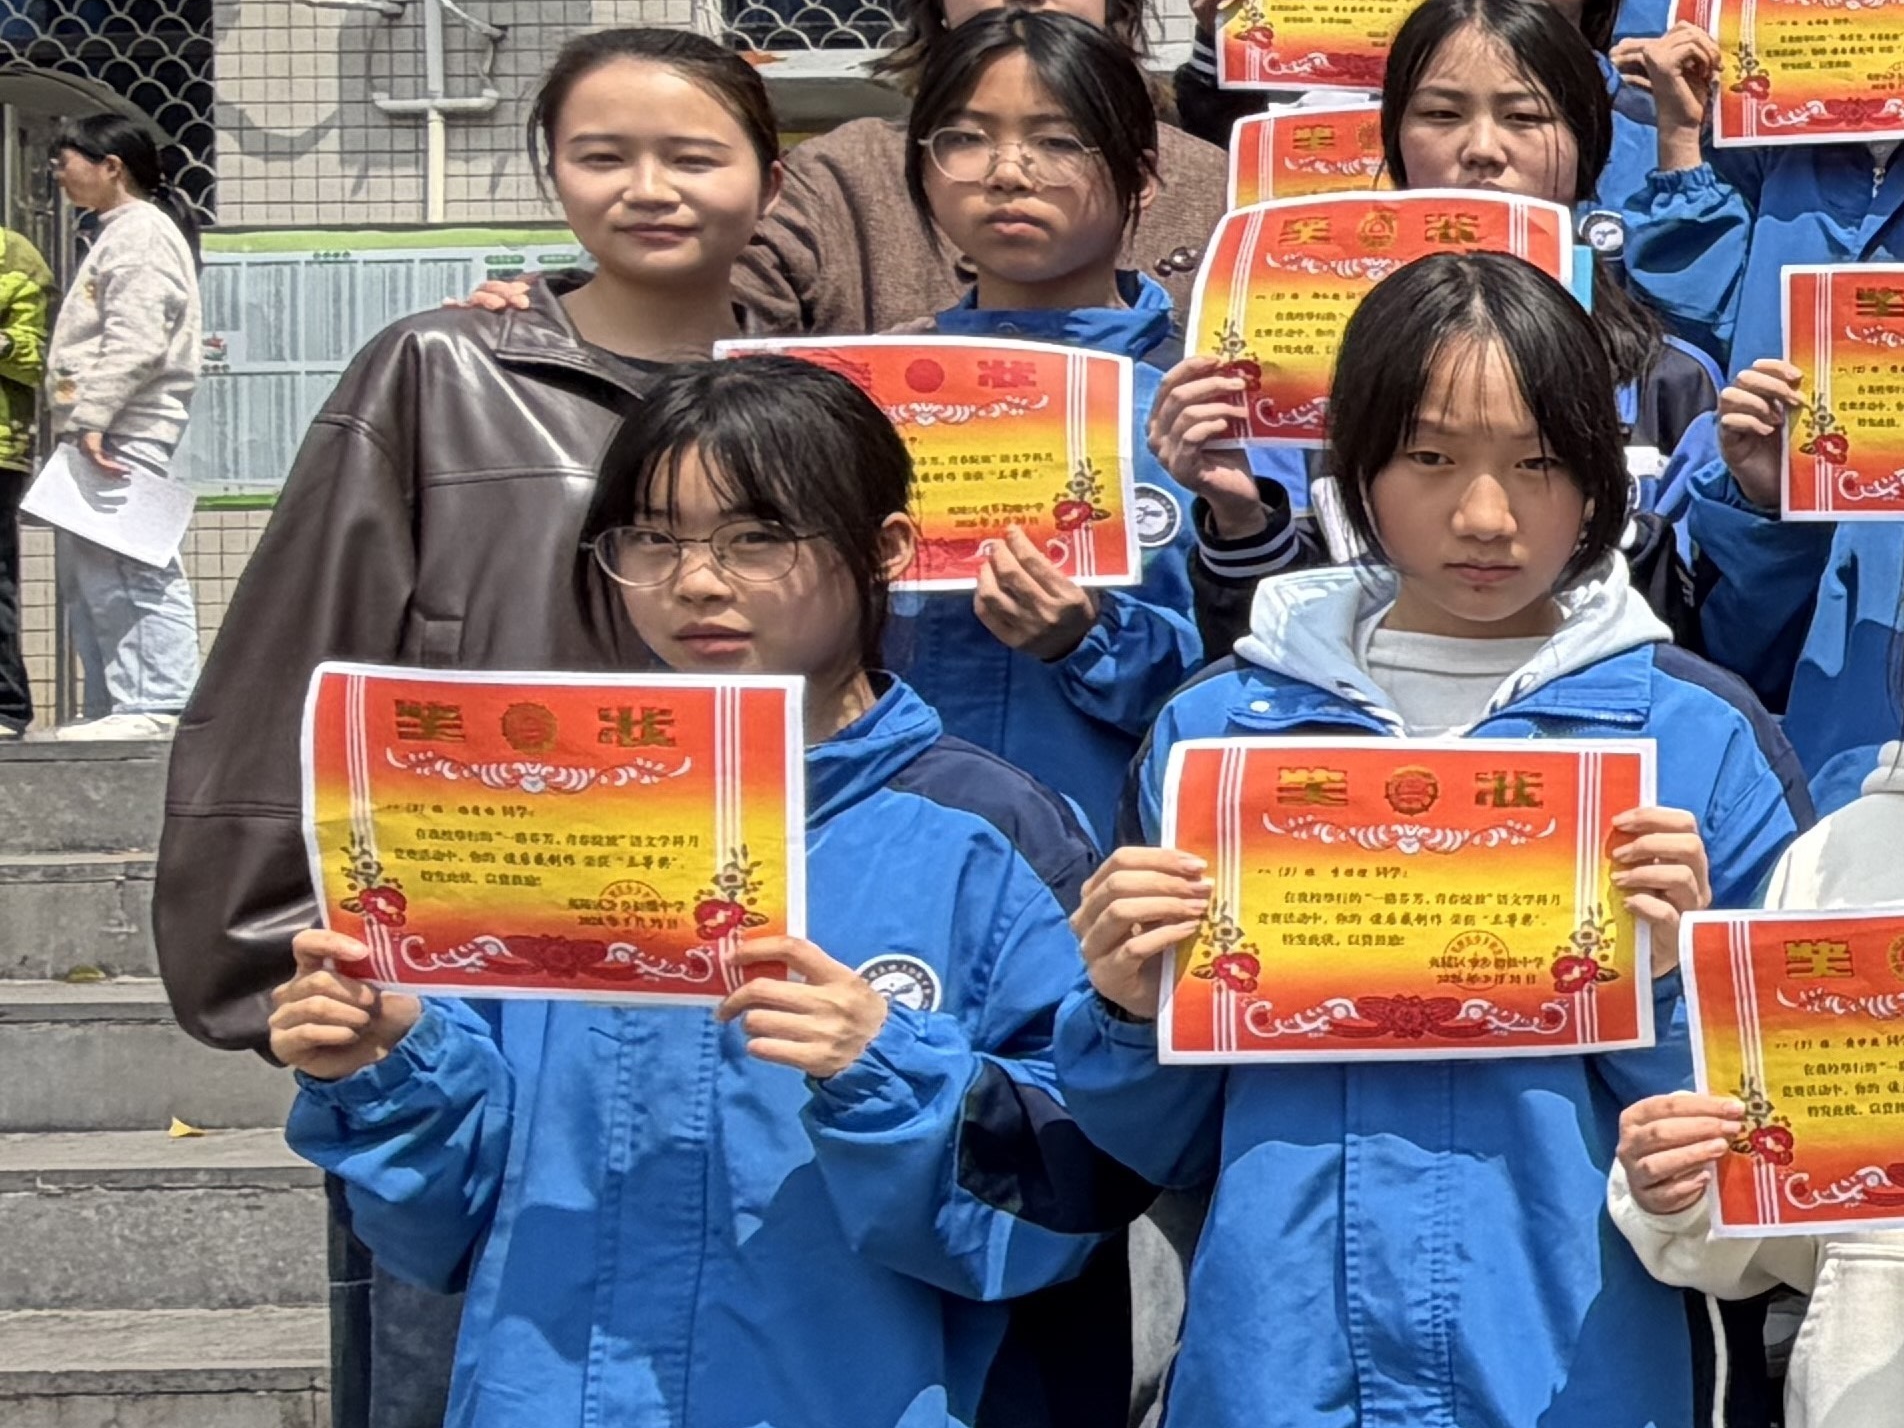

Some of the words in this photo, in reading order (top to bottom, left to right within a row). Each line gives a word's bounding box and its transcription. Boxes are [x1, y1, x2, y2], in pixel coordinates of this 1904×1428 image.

[394, 699, 465, 742] 奖
[598, 706, 675, 747] 状
[1277, 767, 1348, 807] 奖
[1475, 770, 1543, 808] 状
[1783, 939, 1853, 978] 奖
